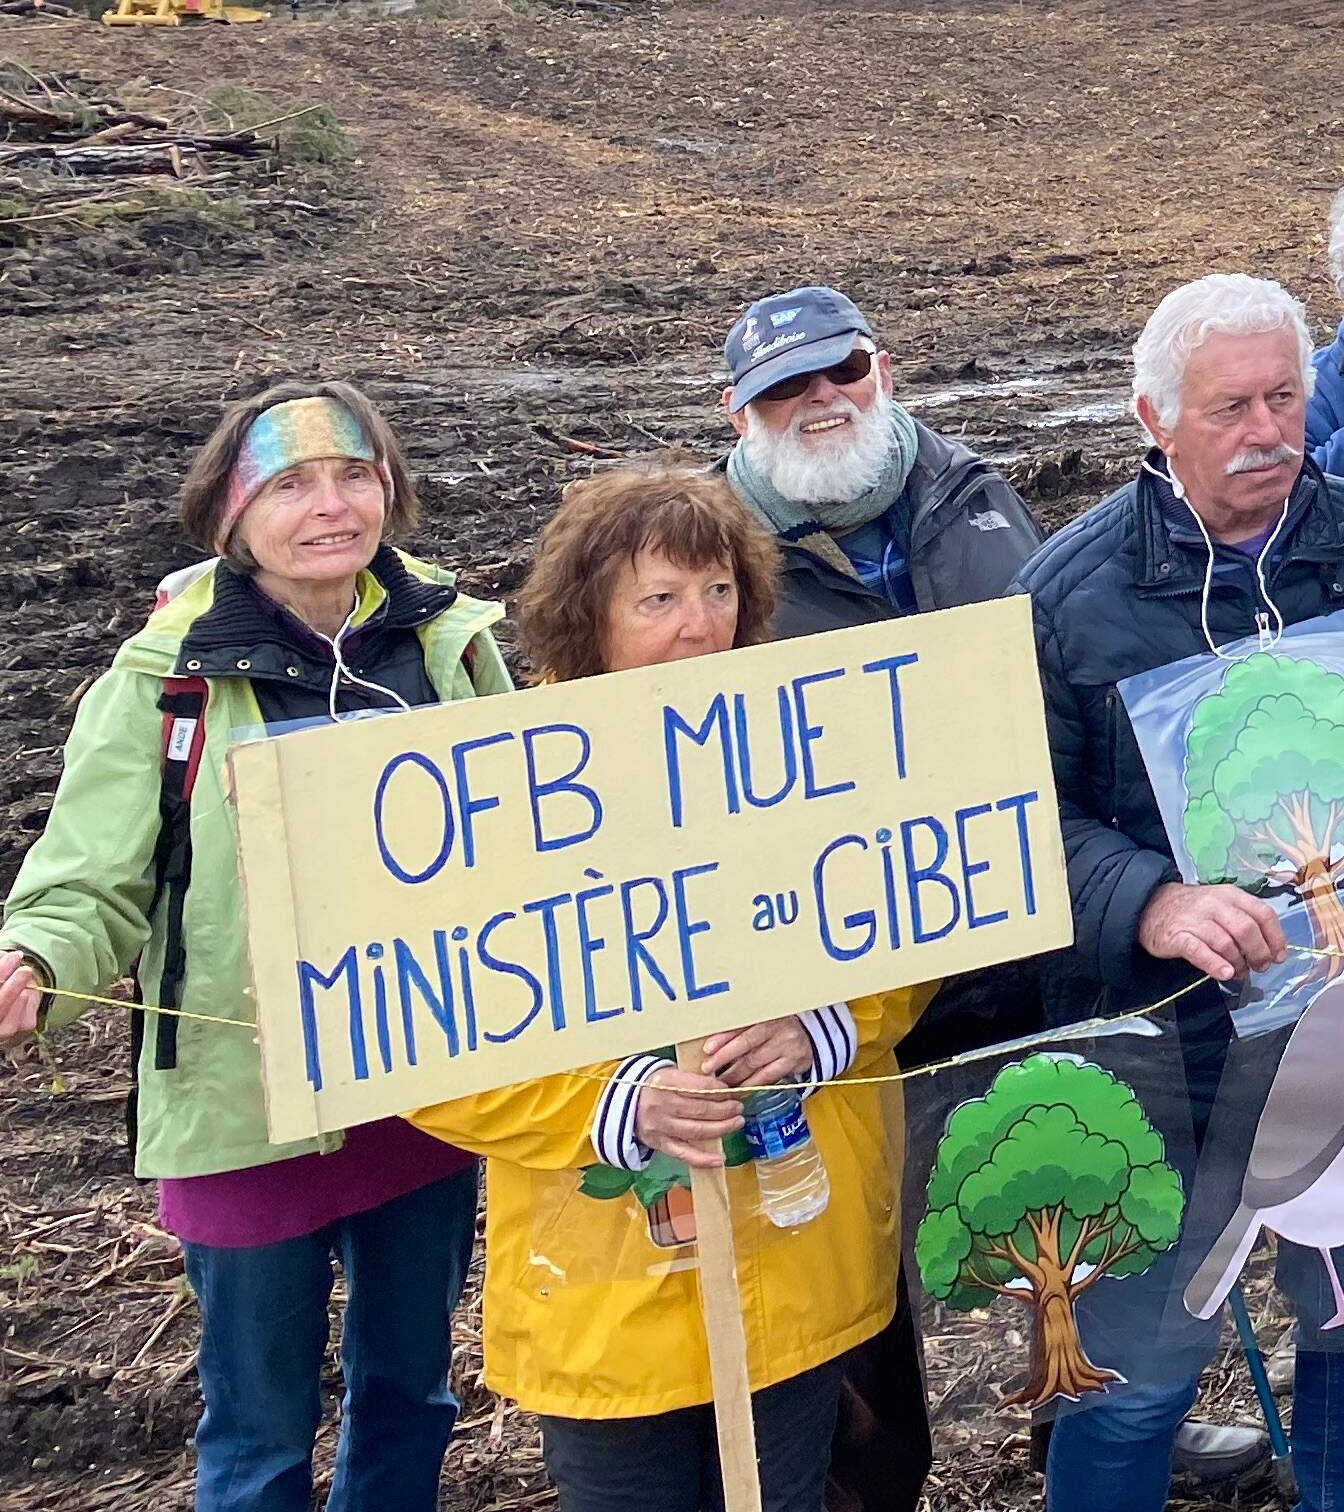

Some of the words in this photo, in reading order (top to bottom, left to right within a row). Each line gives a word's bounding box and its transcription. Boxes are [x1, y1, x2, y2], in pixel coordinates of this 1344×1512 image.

[373, 723, 603, 885] OFB
[662, 652, 919, 828] MUET
[752, 890, 799, 932] au
